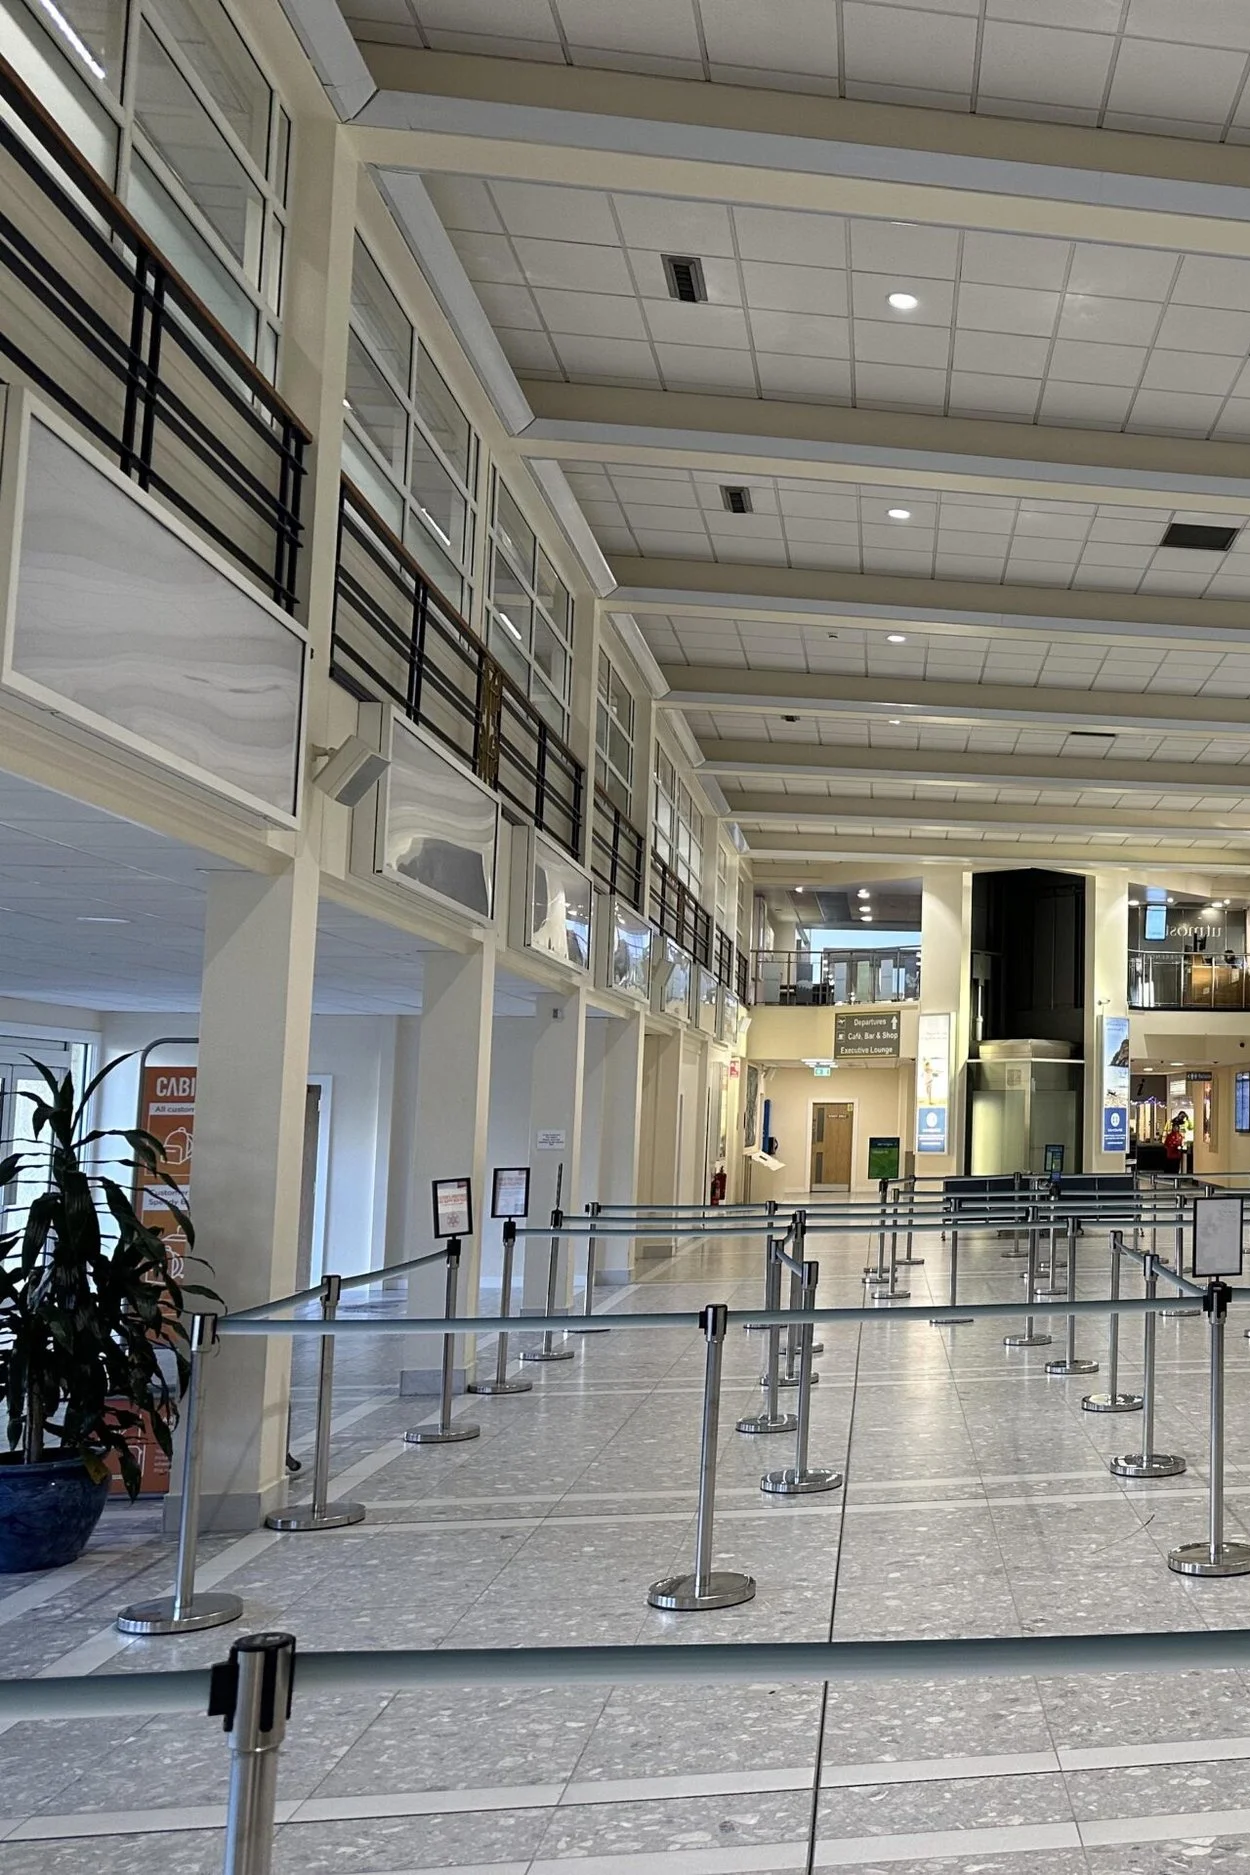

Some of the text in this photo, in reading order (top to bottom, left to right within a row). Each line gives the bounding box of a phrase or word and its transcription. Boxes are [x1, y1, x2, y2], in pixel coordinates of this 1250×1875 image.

[854, 1018, 887, 1028] Departures
[864, 1032, 876, 1041] Bar
[876, 1032, 881, 1040] &
[882, 1031, 899, 1041] Shop
[840, 1046, 893, 1055] Executive Lounge
[155, 1105, 166, 1113] All
